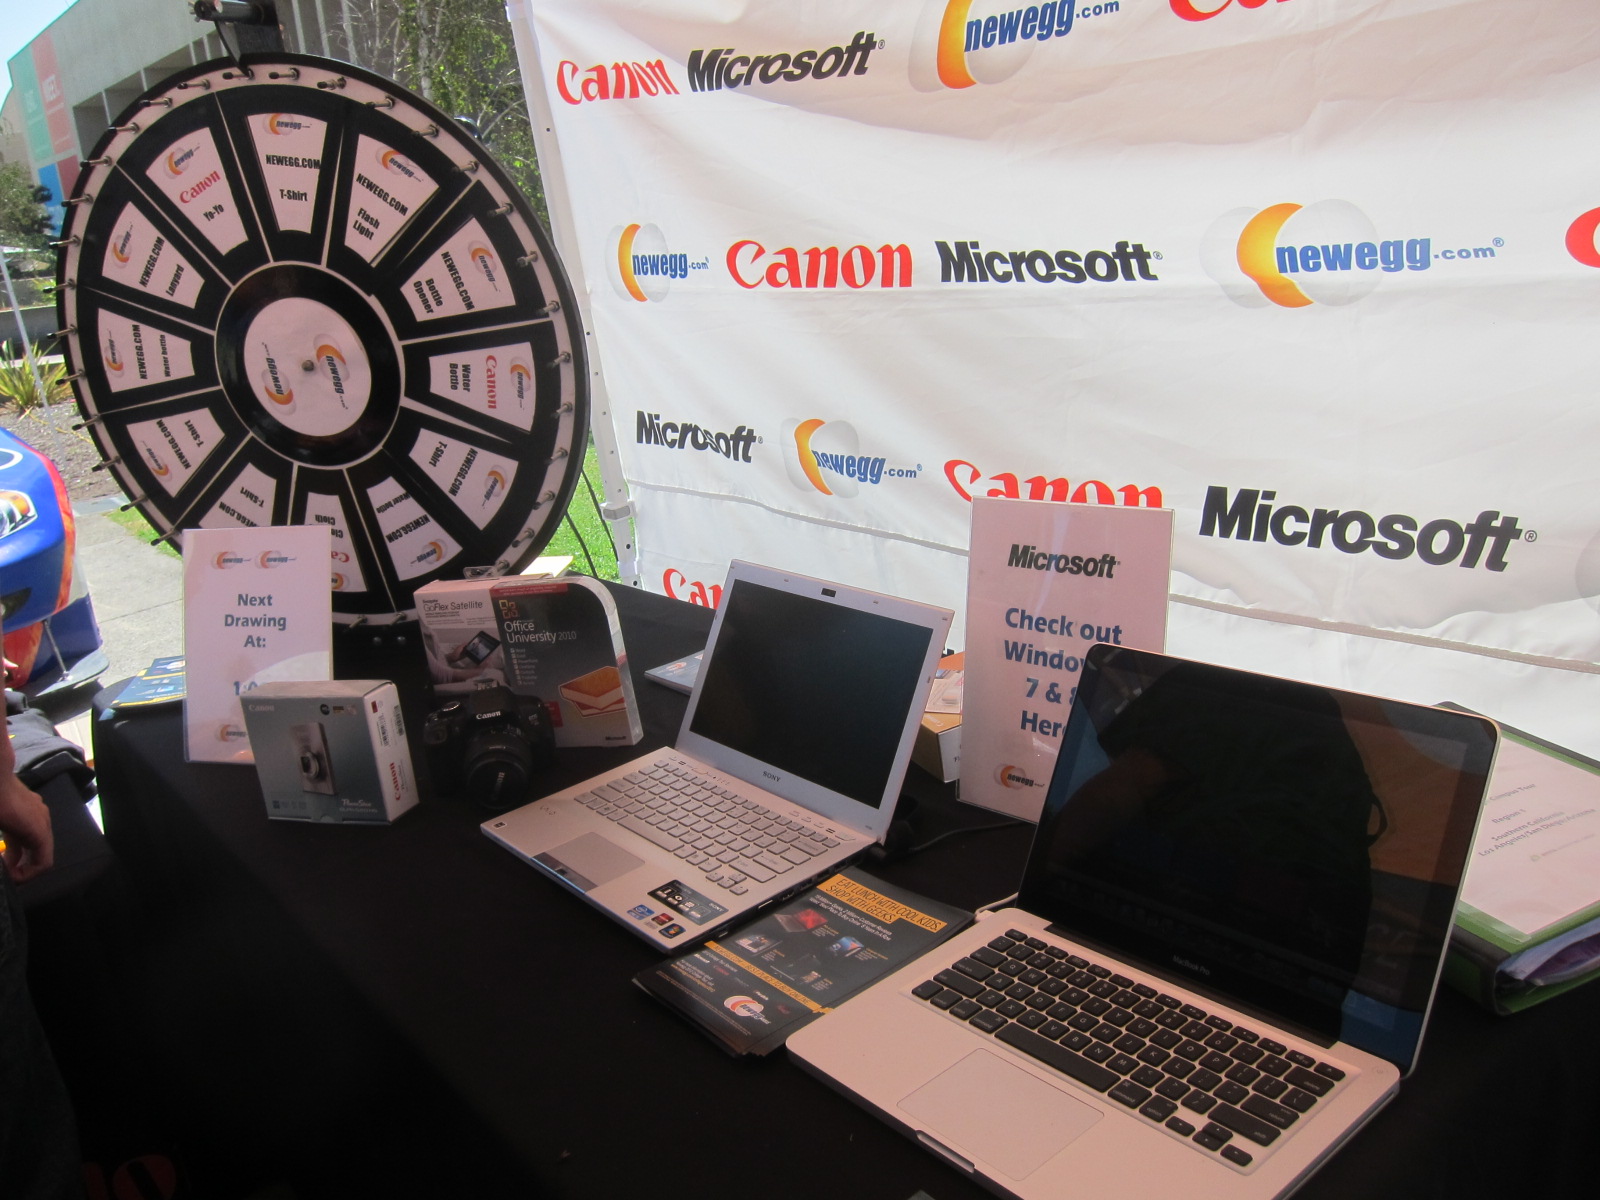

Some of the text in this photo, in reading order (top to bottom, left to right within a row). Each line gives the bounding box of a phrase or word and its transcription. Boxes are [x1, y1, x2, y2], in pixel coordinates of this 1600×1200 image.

[556, 31, 877, 106] Canon Microsoft
[266, 154, 320, 170] NEWEGG.COM
[180, 171, 220, 204] Canon
[280, 189, 308, 202] T-Shirt
[356, 173, 408, 216] NEWEGG.COM
[204, 204, 224, 222] Yo-Yo
[358, 208, 380, 229] Flash
[352, 220, 374, 240] Light
[139, 236, 165, 288] NEWEGG.COM
[726, 240, 912, 289] Canon
[934, 241, 1158, 284] Microsoft
[166, 264, 184, 296] Lanyard
[425, 278, 444, 307] Bottle
[441, 251, 475, 311] NEWEGG.COM
[413, 280, 434, 314] Opener
[132, 324, 148, 380] NEWEGG.COM
[160, 355, 172, 378] Water
[450, 363, 459, 390] Bottle
[462, 364, 470, 392] Water
[485, 354, 498, 410] Canon
[156, 420, 192, 470] NEWEGG.COM
[184, 420, 204, 448] T-Shirt
[429, 441, 448, 467] T-Shirt
[448, 448, 478, 496] NEWEGG.COM
[240, 486, 264, 508] T-Shirt
[636, 410, 756, 463] Microsoft
[1199, 486, 1523, 572] Microsoft
[315, 514, 336, 526] Cloth
[386, 514, 430, 544] NEWEGG.COM
[1008, 544, 1117, 578] Microsoft
[238, 594, 272, 606] Next
[423, 601, 483, 612] GoFlex Satellite
[224, 614, 286, 631] Drawing
[504, 620, 534, 632] Office
[1005, 608, 1122, 644] Check out
[244, 635, 266, 648] At:
[506, 630, 576, 644] University 2010
[1004, 640, 1086, 672] Windo
[1026, 678, 1039, 698] 7
[1046, 682, 1062, 704] &
[476, 711, 500, 720] Canon
[389, 762, 402, 802] Canon
[763, 771, 780, 782] SONY
[1492, 823, 1528, 842] Southern
[1478, 848, 1494, 856] Los
[826, 885, 896, 923] SHOP WITH GEEKS.
[837, 878, 942, 931] EAT LUNCH WITH COOL KIDS.
